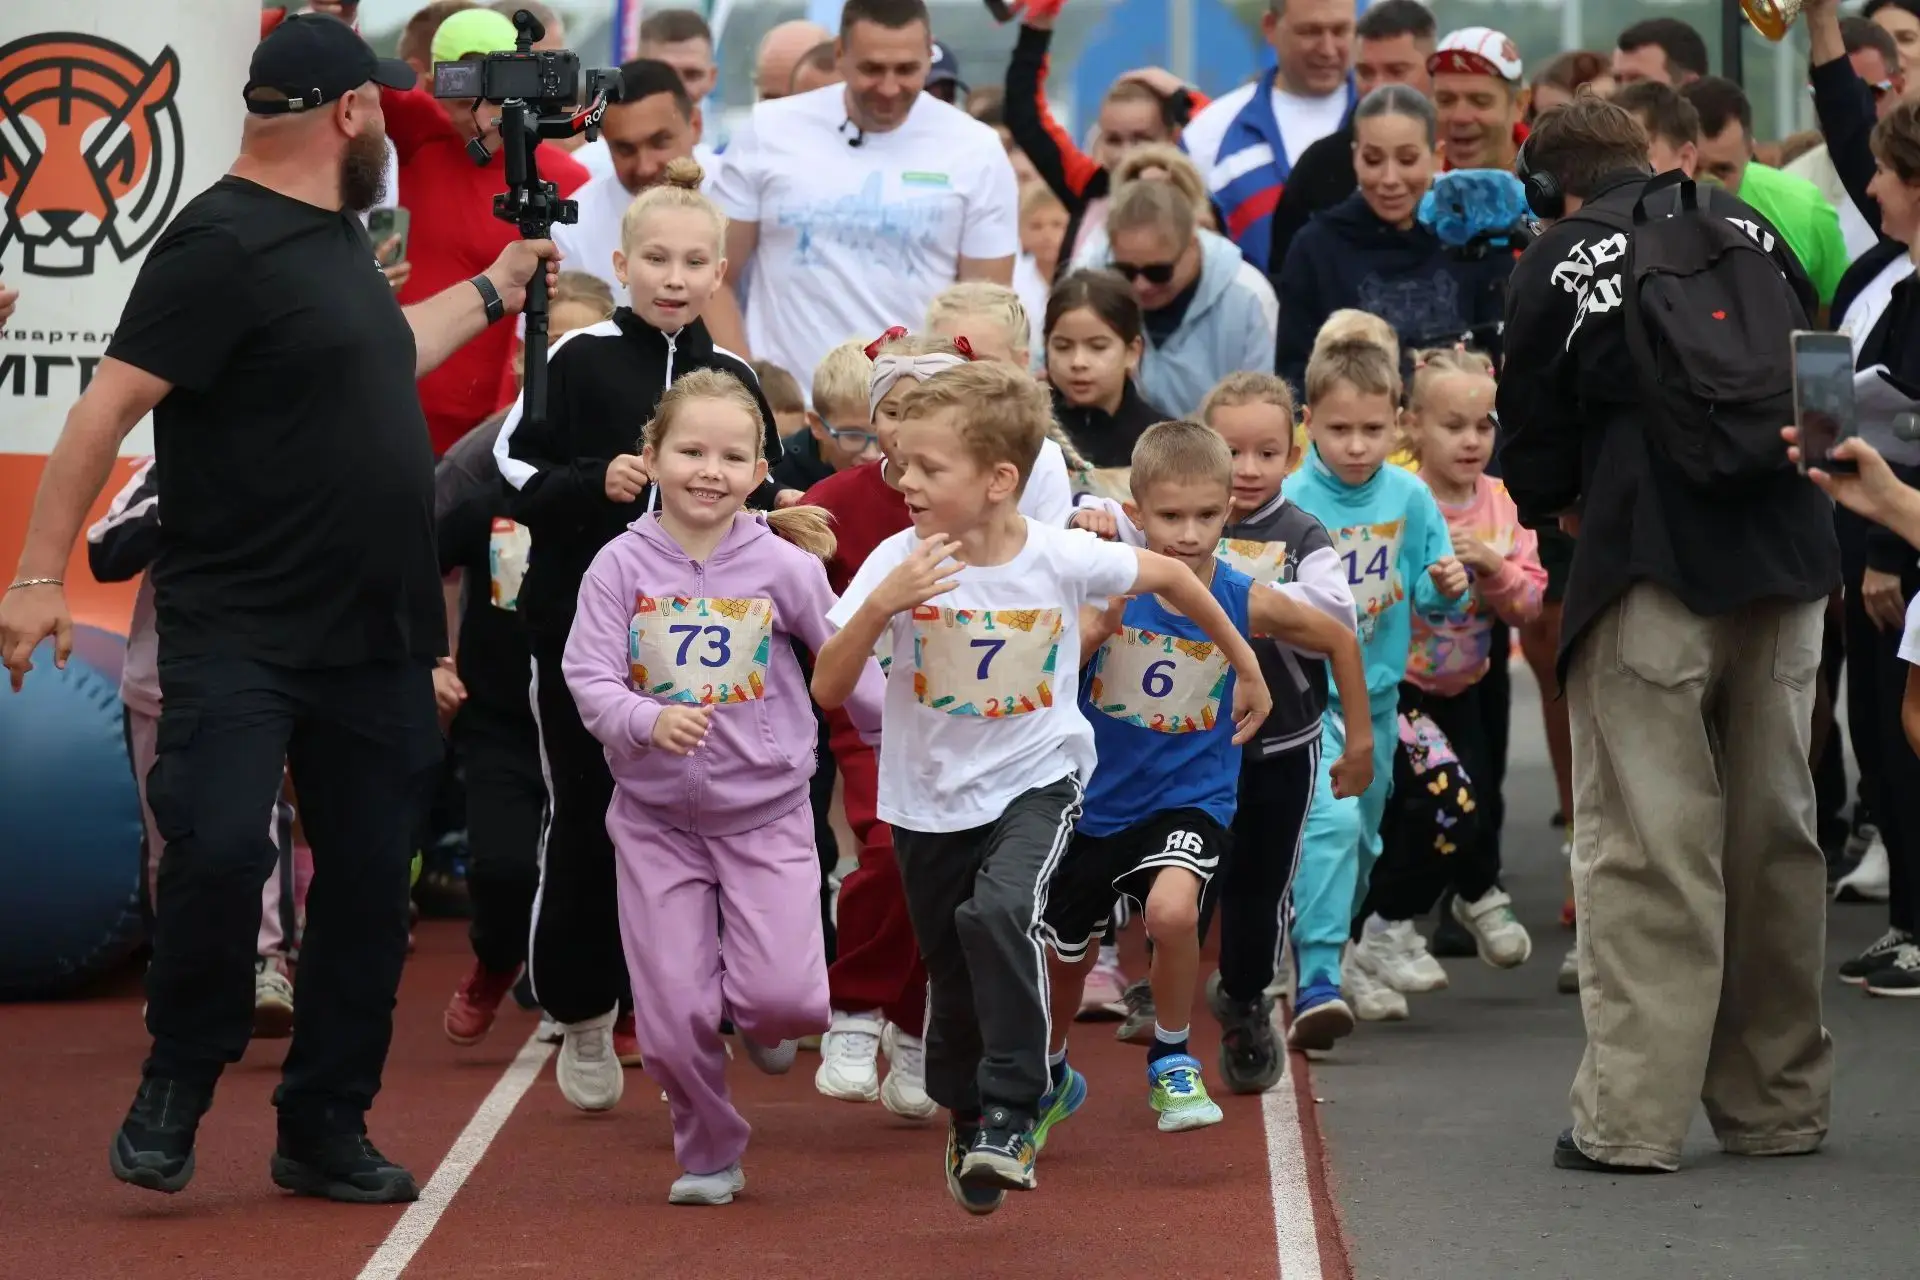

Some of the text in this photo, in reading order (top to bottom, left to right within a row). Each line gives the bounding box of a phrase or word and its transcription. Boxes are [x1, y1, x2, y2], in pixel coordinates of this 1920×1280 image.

[1340, 545, 1389, 585] 14
[697, 598, 709, 616] 1
[982, 611, 995, 630] 1
[669, 624, 731, 668] 73
[970, 639, 1006, 680] 7
[1162, 636, 1173, 653] 1
[1142, 660, 1177, 698] 6
